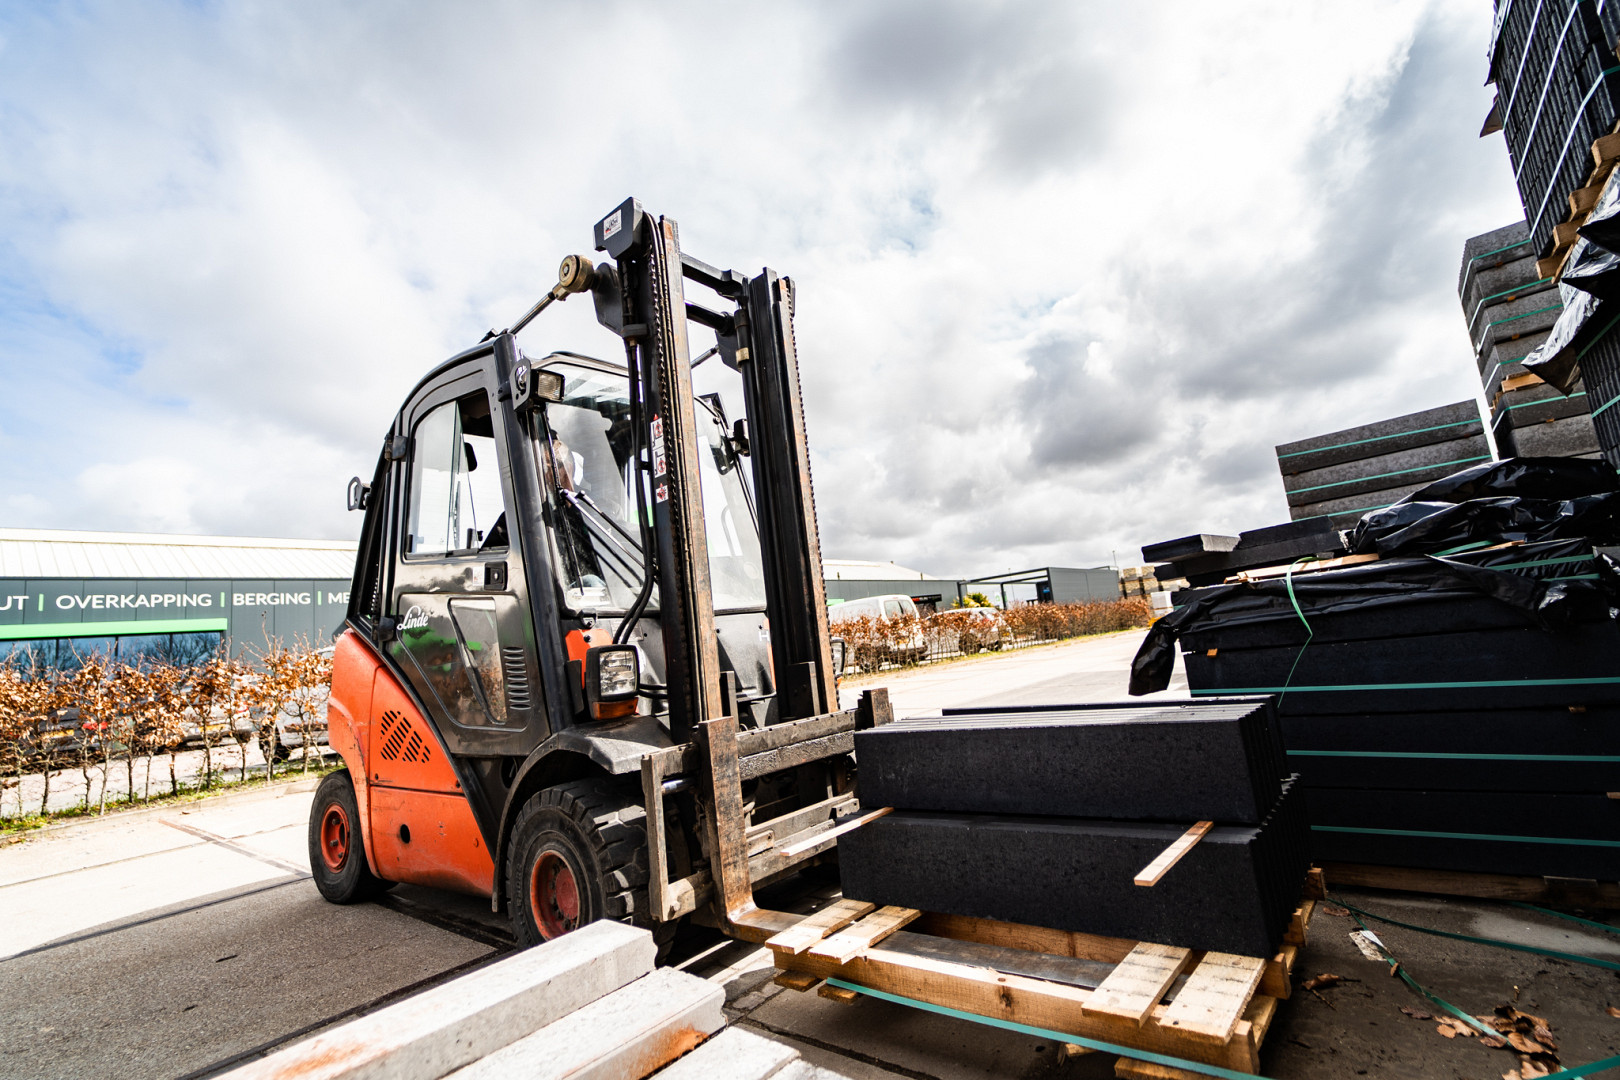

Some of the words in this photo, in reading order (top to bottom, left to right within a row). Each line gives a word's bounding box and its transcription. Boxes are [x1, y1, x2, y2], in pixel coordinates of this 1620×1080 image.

[55, 594, 212, 610] OVERKAPPING
[232, 592, 311, 606] BERGING
[397, 605, 429, 630] Linde
